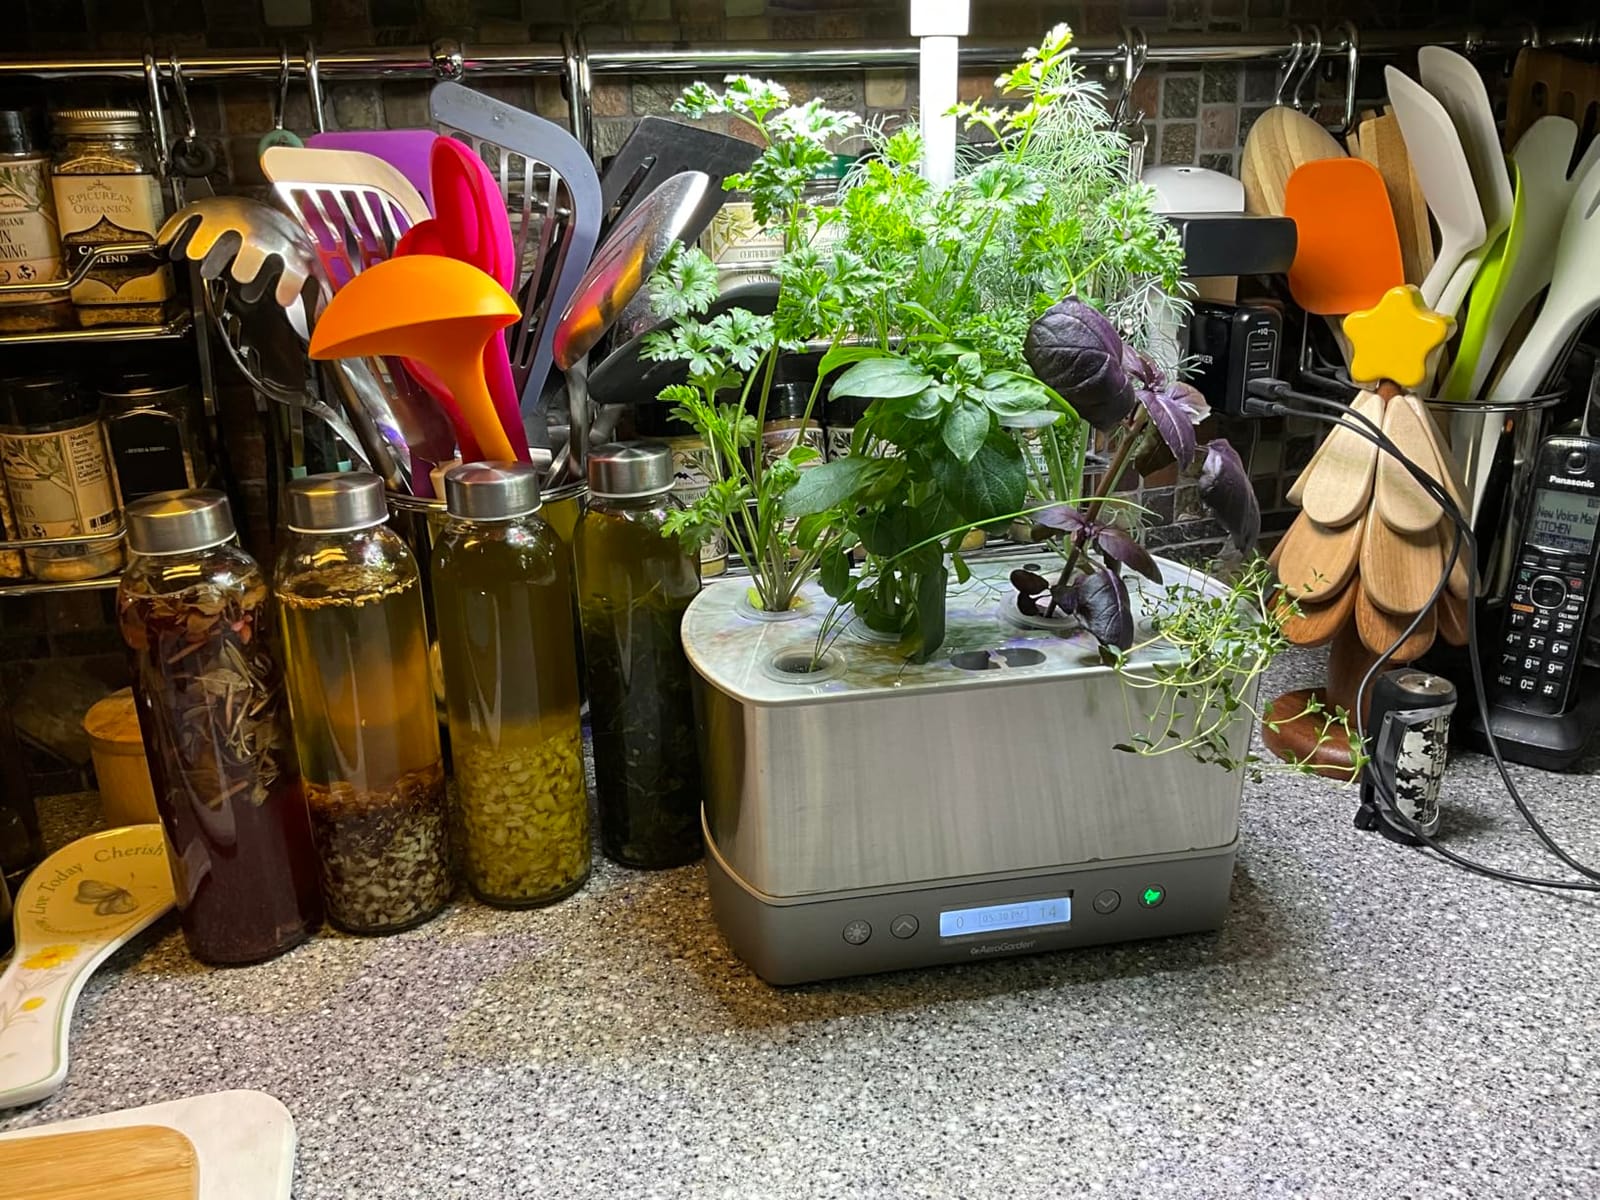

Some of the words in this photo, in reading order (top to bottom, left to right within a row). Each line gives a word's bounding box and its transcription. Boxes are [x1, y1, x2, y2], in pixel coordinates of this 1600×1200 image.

[67, 191, 135, 206] EPICUREAN
[73, 204, 132, 215] ORGANICS
[1549, 475, 1596, 488] Panasonic
[1536, 506, 1554, 519] New
[1556, 508, 1579, 522] Voice
[1532, 617, 1541, 629] 2
[1556, 622, 1565, 633] 3
[1506, 633, 1514, 644] 4
[1528, 638, 1537, 649] 5
[1552, 643, 1560, 654] 6
[1502, 653, 1510, 664] 7
[1524, 658, 1532, 669] 8
[1547, 663, 1555, 674] 9
[1520, 679, 1528, 689] 0
[37, 862, 83, 893] Today
[93, 842, 165, 863] Cherish
[981, 940, 1034, 955] AeroGarden
